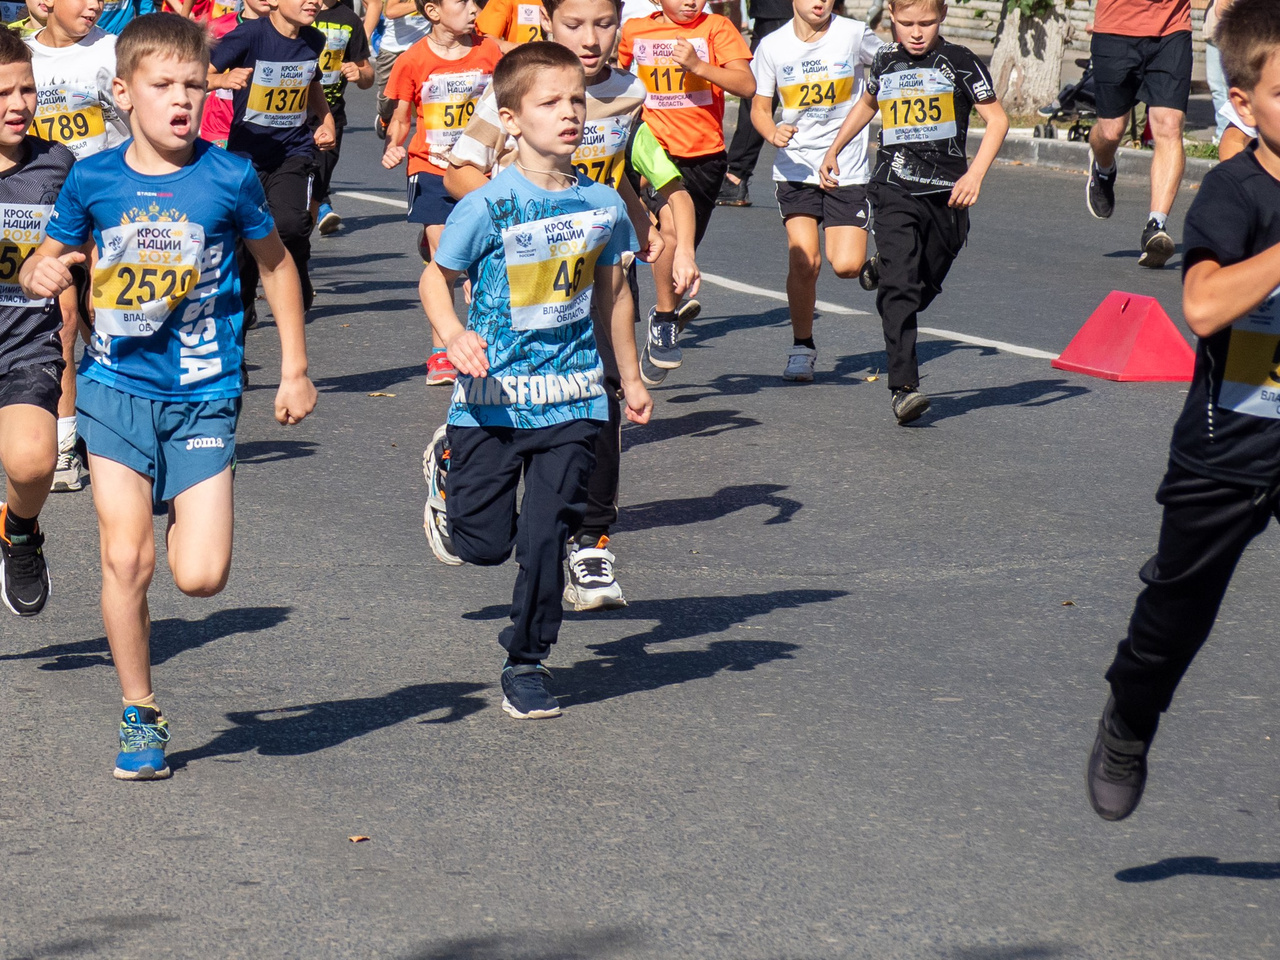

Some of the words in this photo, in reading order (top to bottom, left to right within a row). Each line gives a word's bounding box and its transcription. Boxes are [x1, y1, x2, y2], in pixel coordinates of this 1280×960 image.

[801, 59, 822, 68] КРОСС
[802, 65, 828, 74] НАЦИИ
[280, 78, 303, 87] 2024
[650, 67, 686, 92] 117
[900, 73, 918, 81] КРОСС
[899, 80, 924, 88] НАЦИИ
[447, 86, 473, 95] НАЦИИ
[798, 81, 837, 107] 234
[37, 95, 67, 106] НАЦИИ
[658, 100, 684, 108] ОБЛАСТЬ
[39, 104, 69, 115] 2024
[890, 97, 942, 125] 1735
[32, 112, 90, 141] 1789
[581, 134, 605, 145] АЦИИ
[574, 145, 606, 159] 2024
[3, 208, 34, 220] КРОСС
[3, 219, 41, 230] НАЦИИ
[544, 221, 574, 234] КРОСС
[3, 229, 40, 242] 2024
[137, 228, 171, 239] КРОСС
[546, 229, 585, 245] НАЦИИ
[137, 239, 182, 251] НАЦИИ
[549, 242, 588, 258] 2024
[138, 250, 183, 264] 2024
[553, 257, 585, 297] 46
[542, 294, 589, 316] ВЛАДИМИРСКАЯ
[178, 241, 225, 386] RUSSIA
[556, 308, 585, 324] ОБЛАСТЬ
